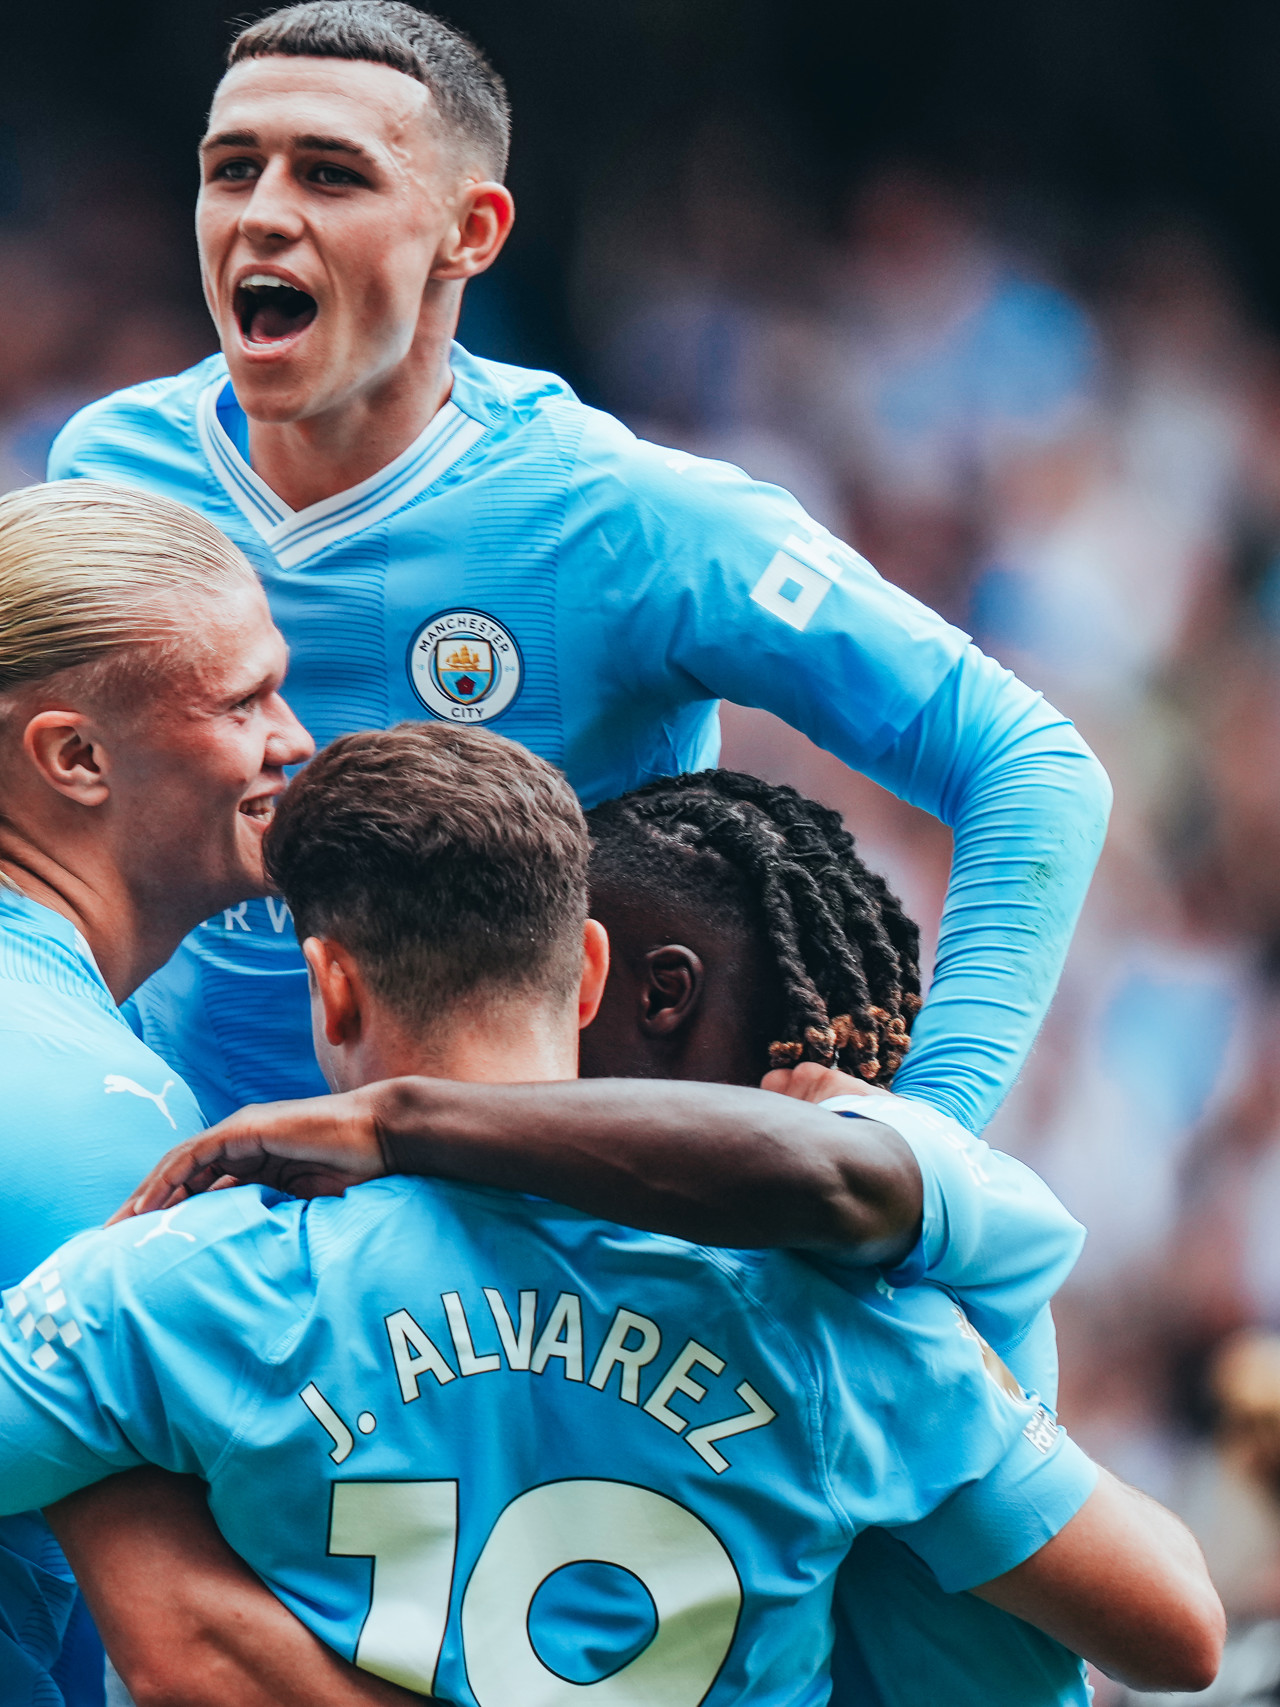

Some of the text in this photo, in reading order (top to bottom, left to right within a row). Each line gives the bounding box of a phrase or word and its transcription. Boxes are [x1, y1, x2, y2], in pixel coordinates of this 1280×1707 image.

[419, 617, 509, 653] MANCHESTER
[451, 707, 484, 718] CITY
[299, 1287, 778, 1475] J. ALVAREZ
[327, 1477, 745, 1707] 10
